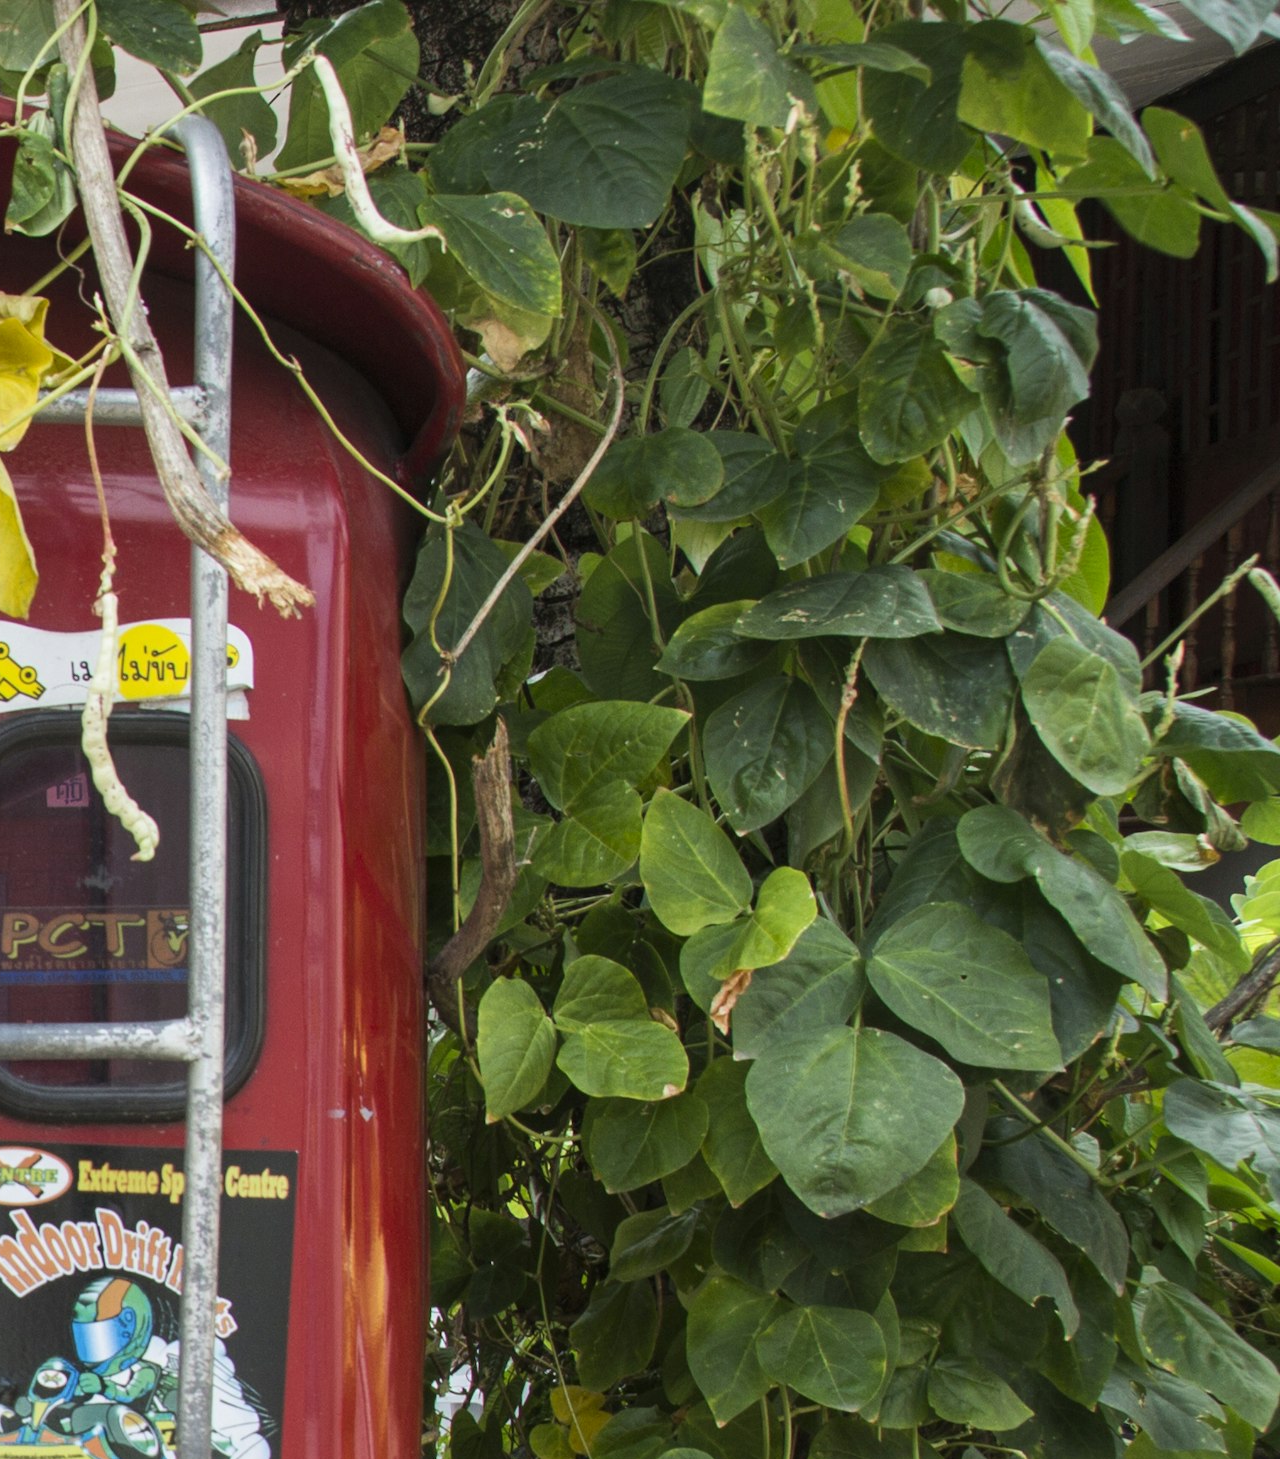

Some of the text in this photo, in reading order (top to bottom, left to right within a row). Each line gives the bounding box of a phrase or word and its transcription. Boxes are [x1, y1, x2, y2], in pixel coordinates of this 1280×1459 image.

[1, 913, 146, 959] PCT
[77, 1160, 160, 1195] Extreme
[225, 1166, 289, 1199] Centre
[95, 1207, 172, 1283] Drift
